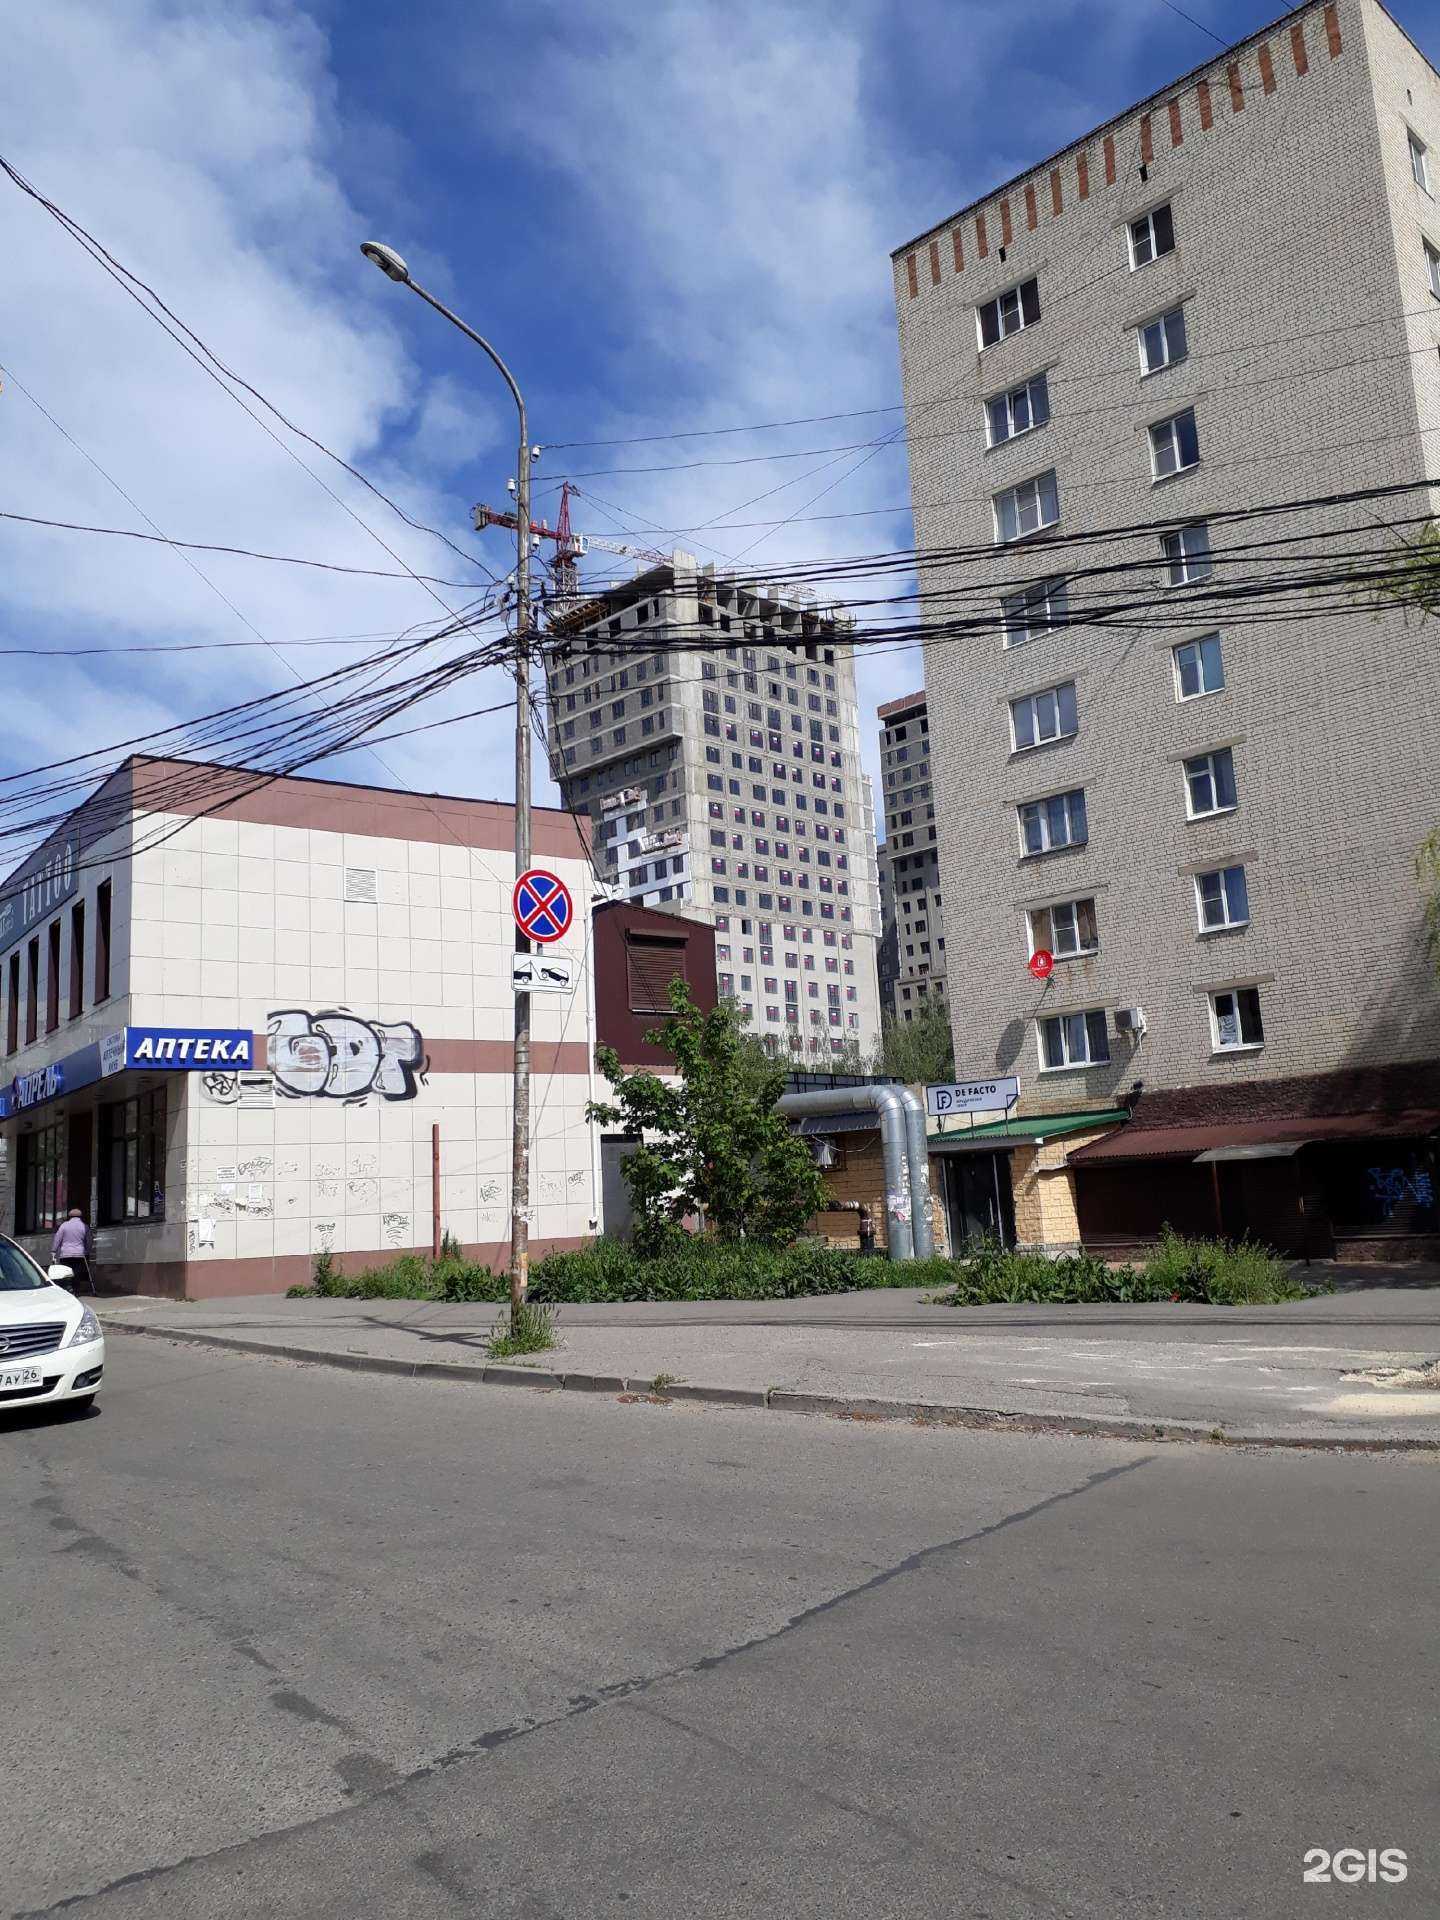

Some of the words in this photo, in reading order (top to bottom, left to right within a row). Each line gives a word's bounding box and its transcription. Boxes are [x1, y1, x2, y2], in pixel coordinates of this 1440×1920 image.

[23, 844, 72, 925] TATTOO
[133, 1037, 249, 1061] АПТЕКА
[17, 1065, 57, 1109] АПРЕЛЬ
[955, 1088, 966, 1097] DE
[968, 1085, 997, 1096] FACTO
[24, 1369, 37, 1380] 26
